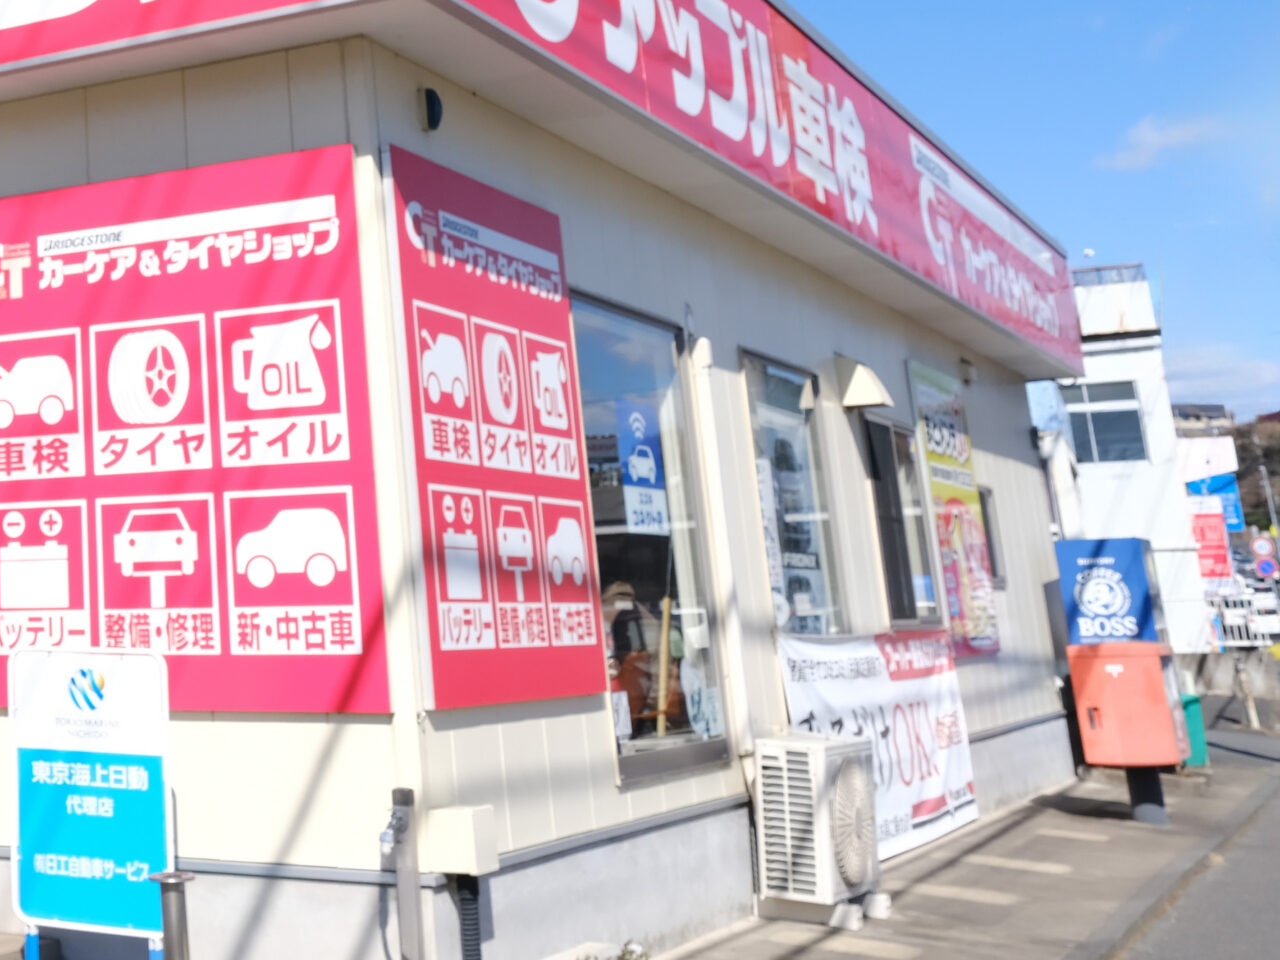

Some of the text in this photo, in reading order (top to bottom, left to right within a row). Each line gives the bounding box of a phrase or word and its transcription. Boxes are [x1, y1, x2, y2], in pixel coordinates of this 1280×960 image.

[37, 217, 340, 290] カーケア&タイヤショップ
[43, 230, 123, 252] BRIDGESTONE
[261, 361, 312, 396] OIL
[100, 430, 205, 469] タイヤ
[227, 420, 342, 461] オイル
[430, 418, 473, 461] 車検
[484, 428, 528, 467] タイヤ
[534, 438, 577, 473] オイル
[1077, 615, 1140, 637] BOSS
[31, 760, 149, 791] 東京海上日動
[65, 795, 114, 818] 代理店
